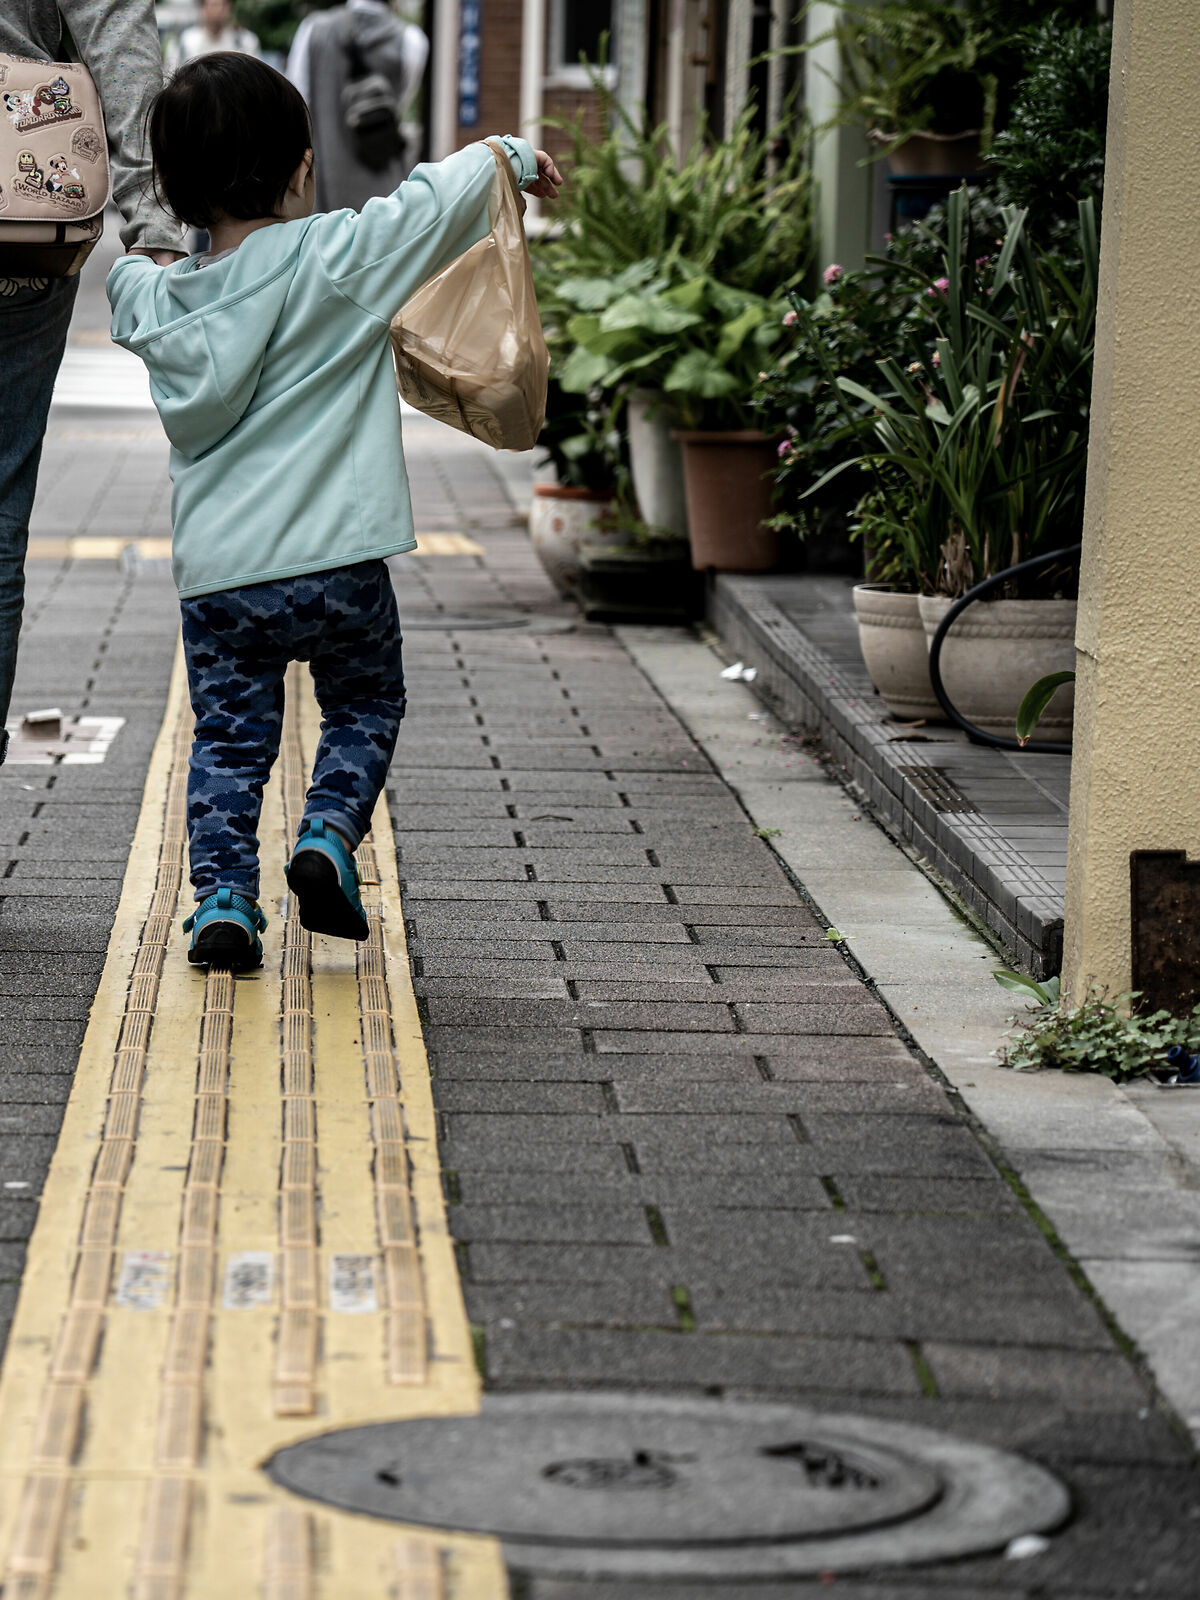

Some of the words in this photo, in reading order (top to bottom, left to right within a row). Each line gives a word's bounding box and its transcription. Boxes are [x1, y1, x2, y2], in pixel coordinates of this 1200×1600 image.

[15, 106, 82, 130] TOMORROWND
[18, 183, 48, 197] WORLD
[49, 191, 83, 208] BAZAAR
